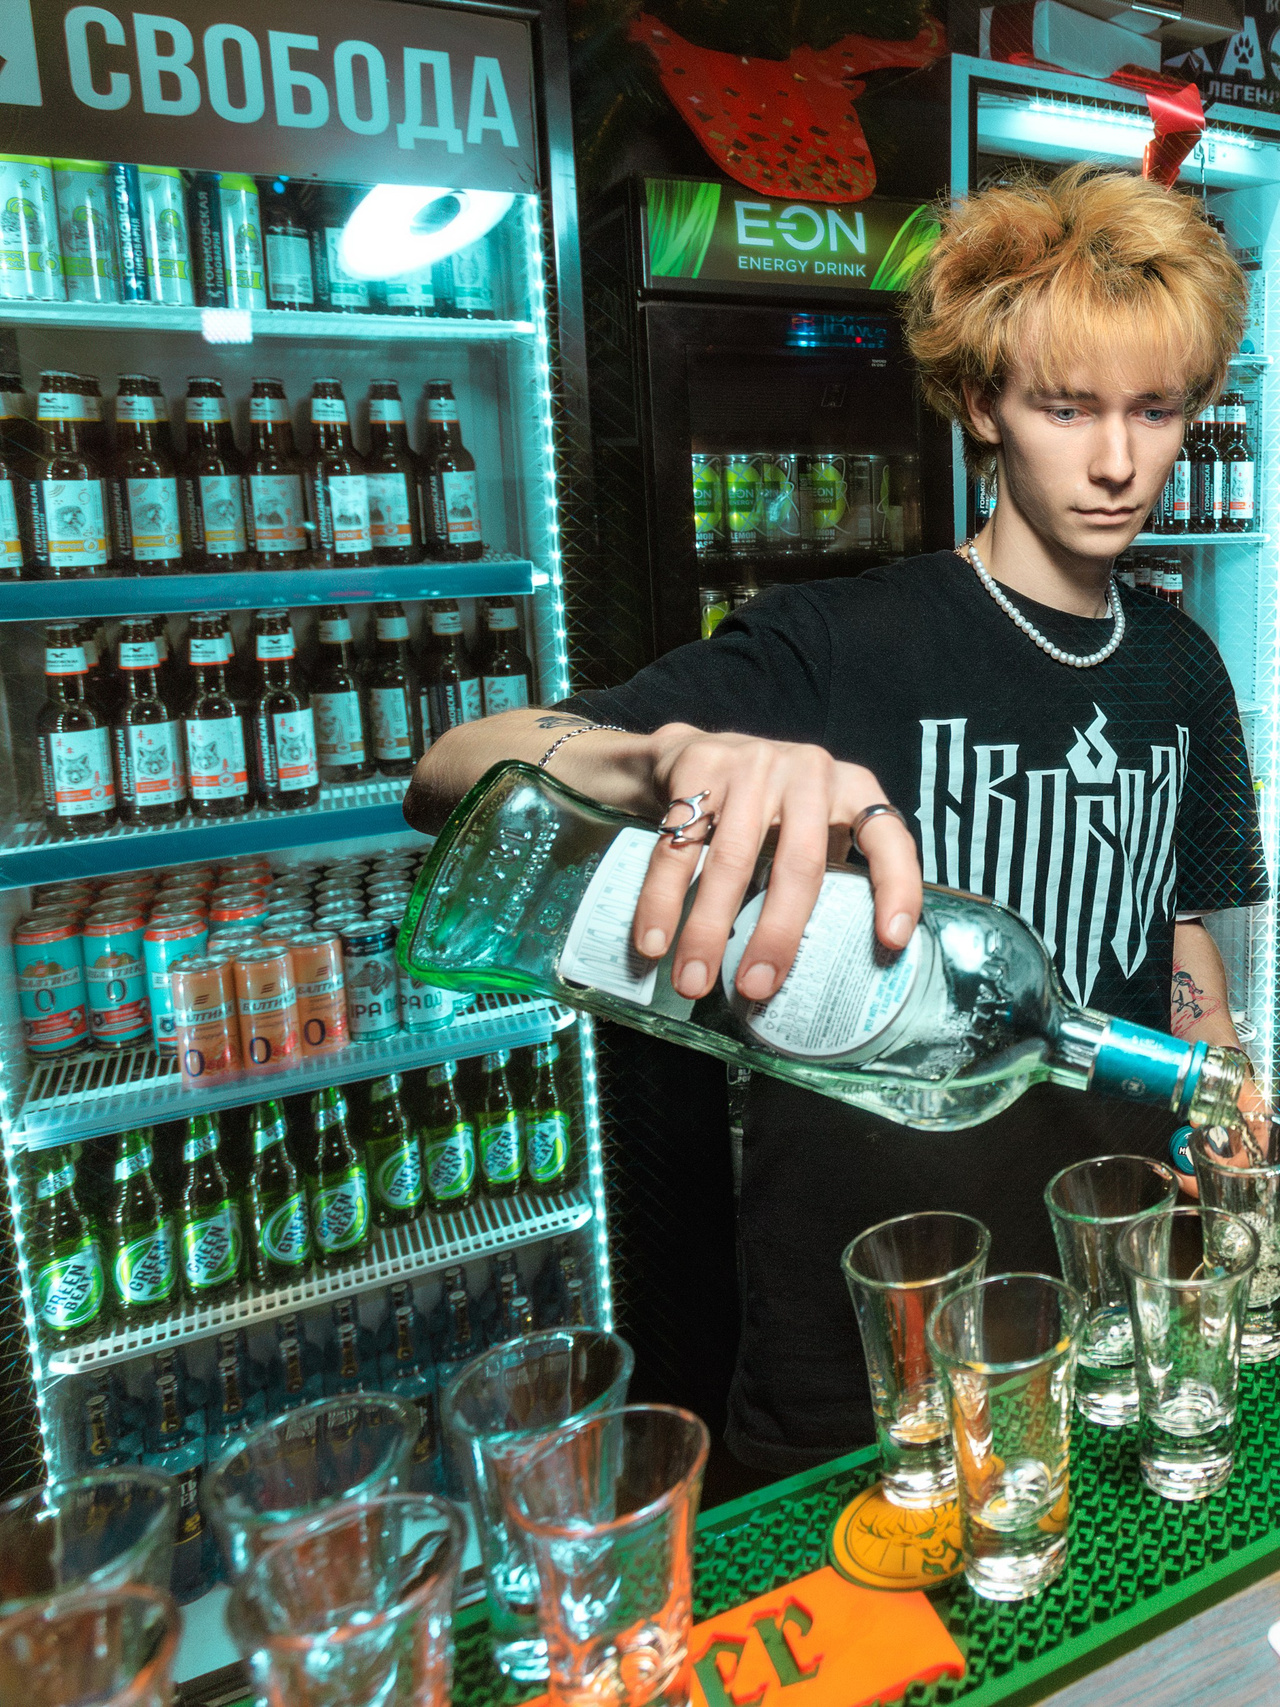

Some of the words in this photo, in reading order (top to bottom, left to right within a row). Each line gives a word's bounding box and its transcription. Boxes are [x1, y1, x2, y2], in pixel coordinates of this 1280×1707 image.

[64, 6, 519, 153] СВОБОДА
[738, 255, 808, 273] ENERGY
[814, 261, 866, 277] DRINK
[35, 988, 55, 1013] 0
[106, 979, 127, 1002] 0
[242, 990, 296, 1013] БАЛТИКА
[250, 1036, 271, 1064] 0
[304, 1018, 326, 1046] 0
[184, 1049, 205, 1077] 0
[390, 1151, 420, 1197] GREEN
[430, 1145, 459, 1187] GREEN
[318, 1192, 353, 1238] GREEN
[334, 1204, 358, 1236] BEAT
[129, 1238, 168, 1292] GREEN
[188, 1225, 225, 1274] GREEN
[204, 1235, 230, 1271] BEAT
[45, 1263, 86, 1316] GREEN
[64, 1272, 94, 1312] BEAT
